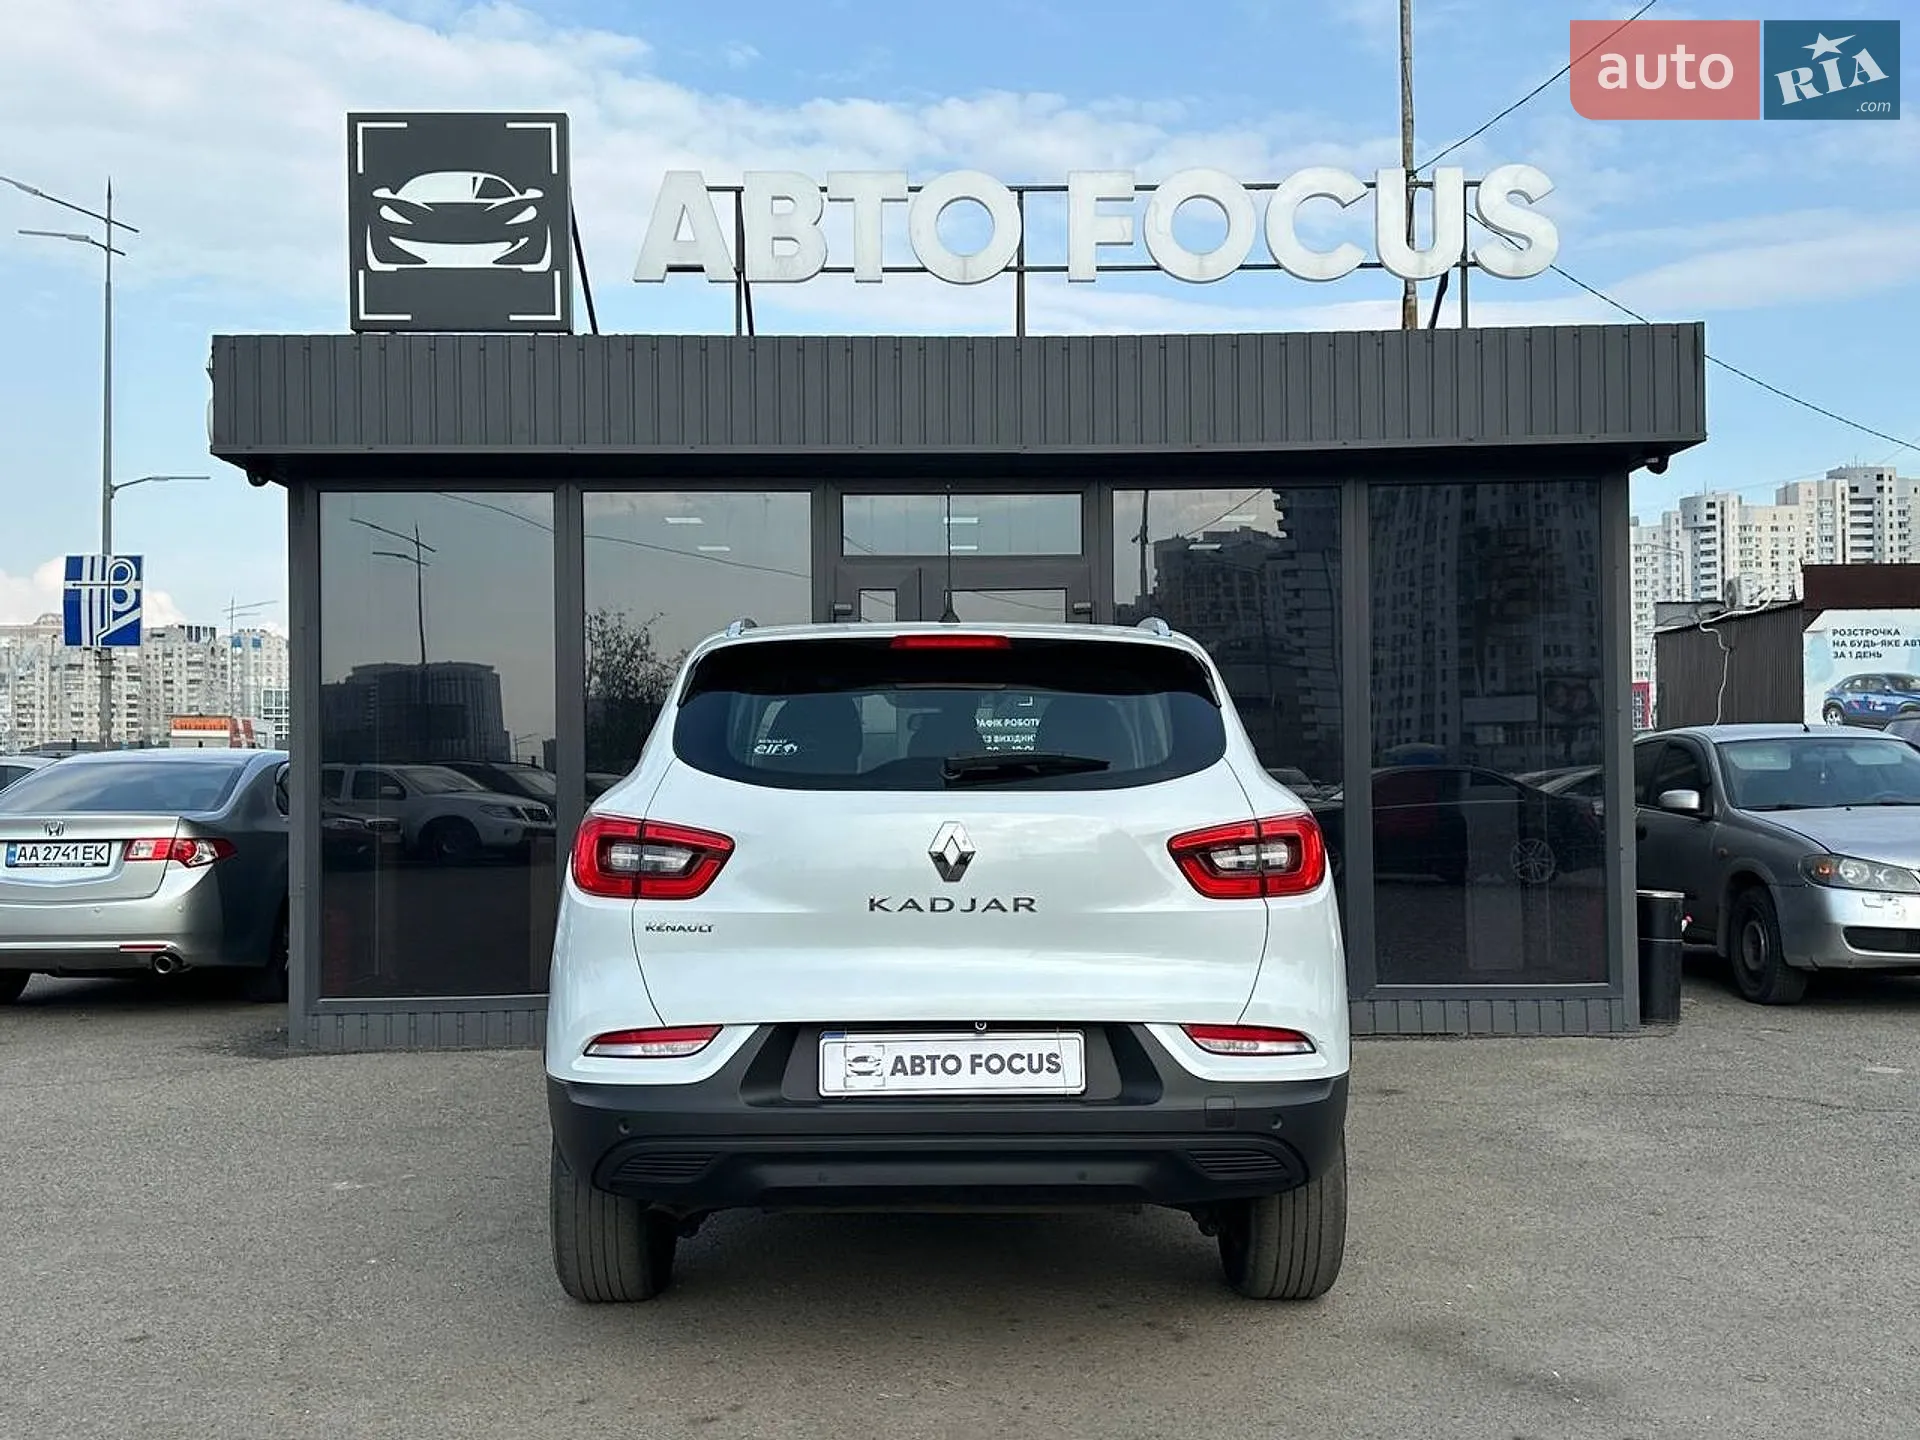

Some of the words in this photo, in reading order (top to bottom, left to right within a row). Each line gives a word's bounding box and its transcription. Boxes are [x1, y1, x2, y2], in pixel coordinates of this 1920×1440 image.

[633, 170, 1021, 284] АВТО
[1068, 164, 1559, 283] FOCUS
[1832, 628, 1901, 637] РОЗСТРОЧКА
[1832, 639, 1847, 648] НА
[1849, 639, 1901, 648] БУДЬ-ЯКЕ
[1833, 651, 1846, 659] ЗА
[1849, 651, 1853, 659] 1
[1855, 651, 1883, 660] ДЕНЬ
[17, 845, 39, 861] AA
[42, 845, 79, 861] 2741
[82, 845, 106, 861] EK
[868, 896, 1038, 914] KADJAR
[645, 922, 714, 933] RENAULT
[890, 1054, 963, 1077] АВТО
[970, 1053, 1062, 1075] FOCUS
